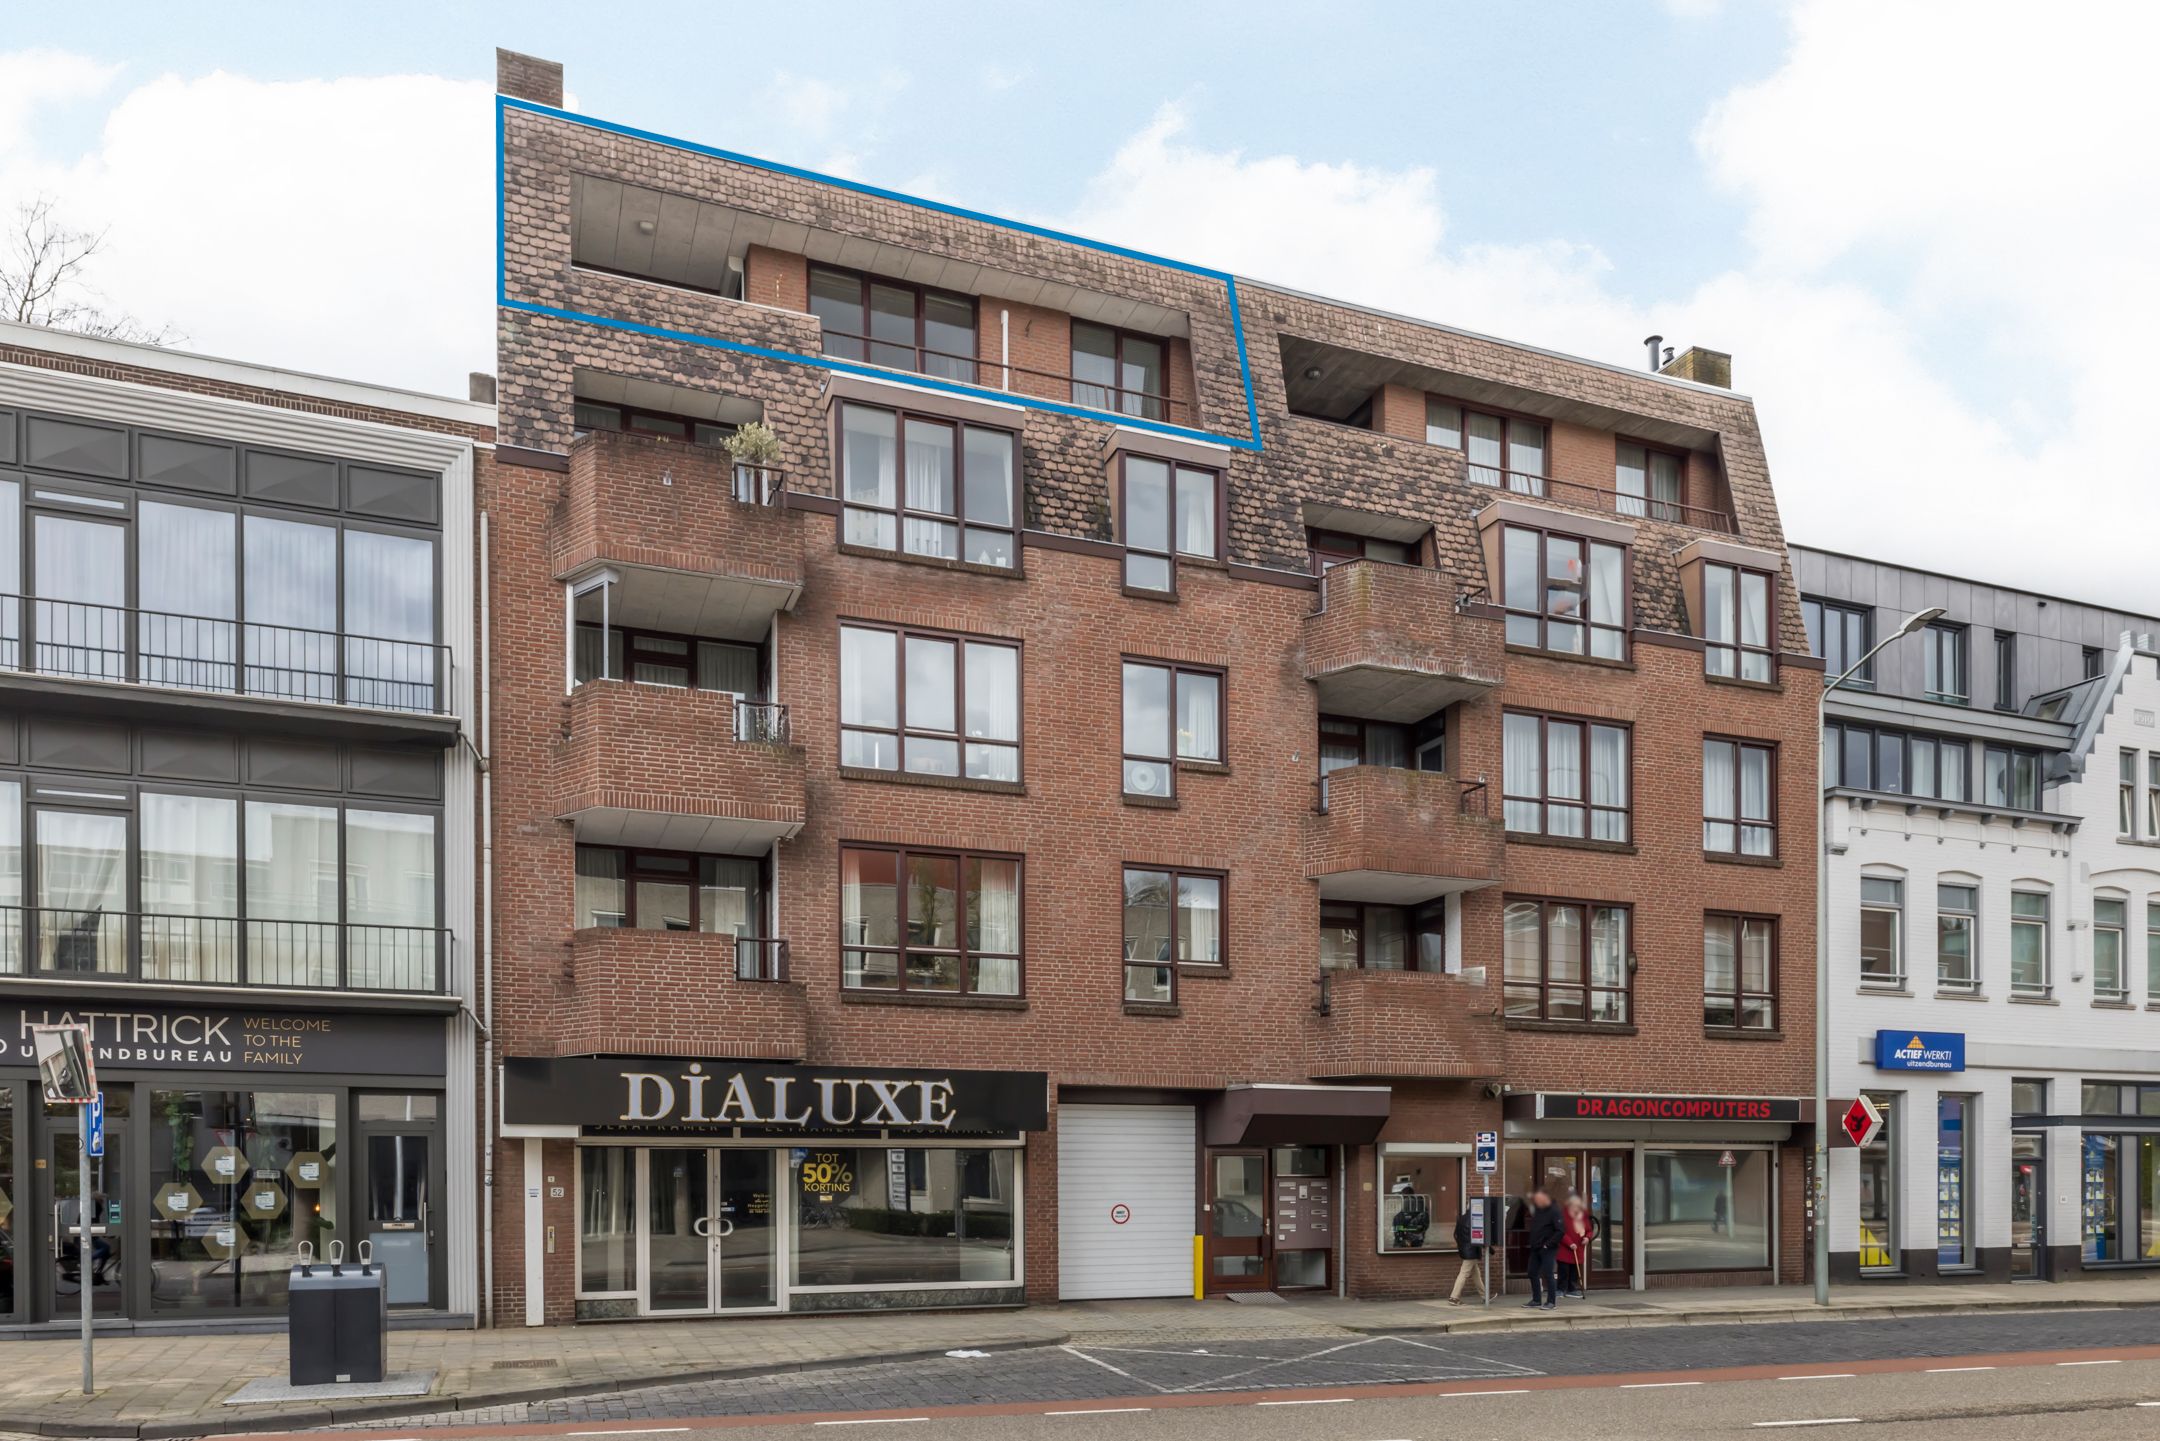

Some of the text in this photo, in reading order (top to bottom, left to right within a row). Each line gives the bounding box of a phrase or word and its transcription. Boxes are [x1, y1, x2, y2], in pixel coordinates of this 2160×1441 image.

[243, 1017, 331, 1031] WELCOME
[243, 1034, 302, 1047] TO THE
[21, 1045, 231, 1062] UNDBUREAU
[244, 1051, 303, 1065] FAMILY
[1894, 1049, 1923, 1059] ACTIEF
[1906, 1060, 1952, 1068] uitzendbureau
[1577, 1099, 1771, 1118] DRAGONCOMPUTERS
[816, 1153, 839, 1163] TOT
[802, 1163, 853, 1183] 50%
[552, 1188, 562, 1197] 52
[804, 1183, 850, 1192] KORTING
